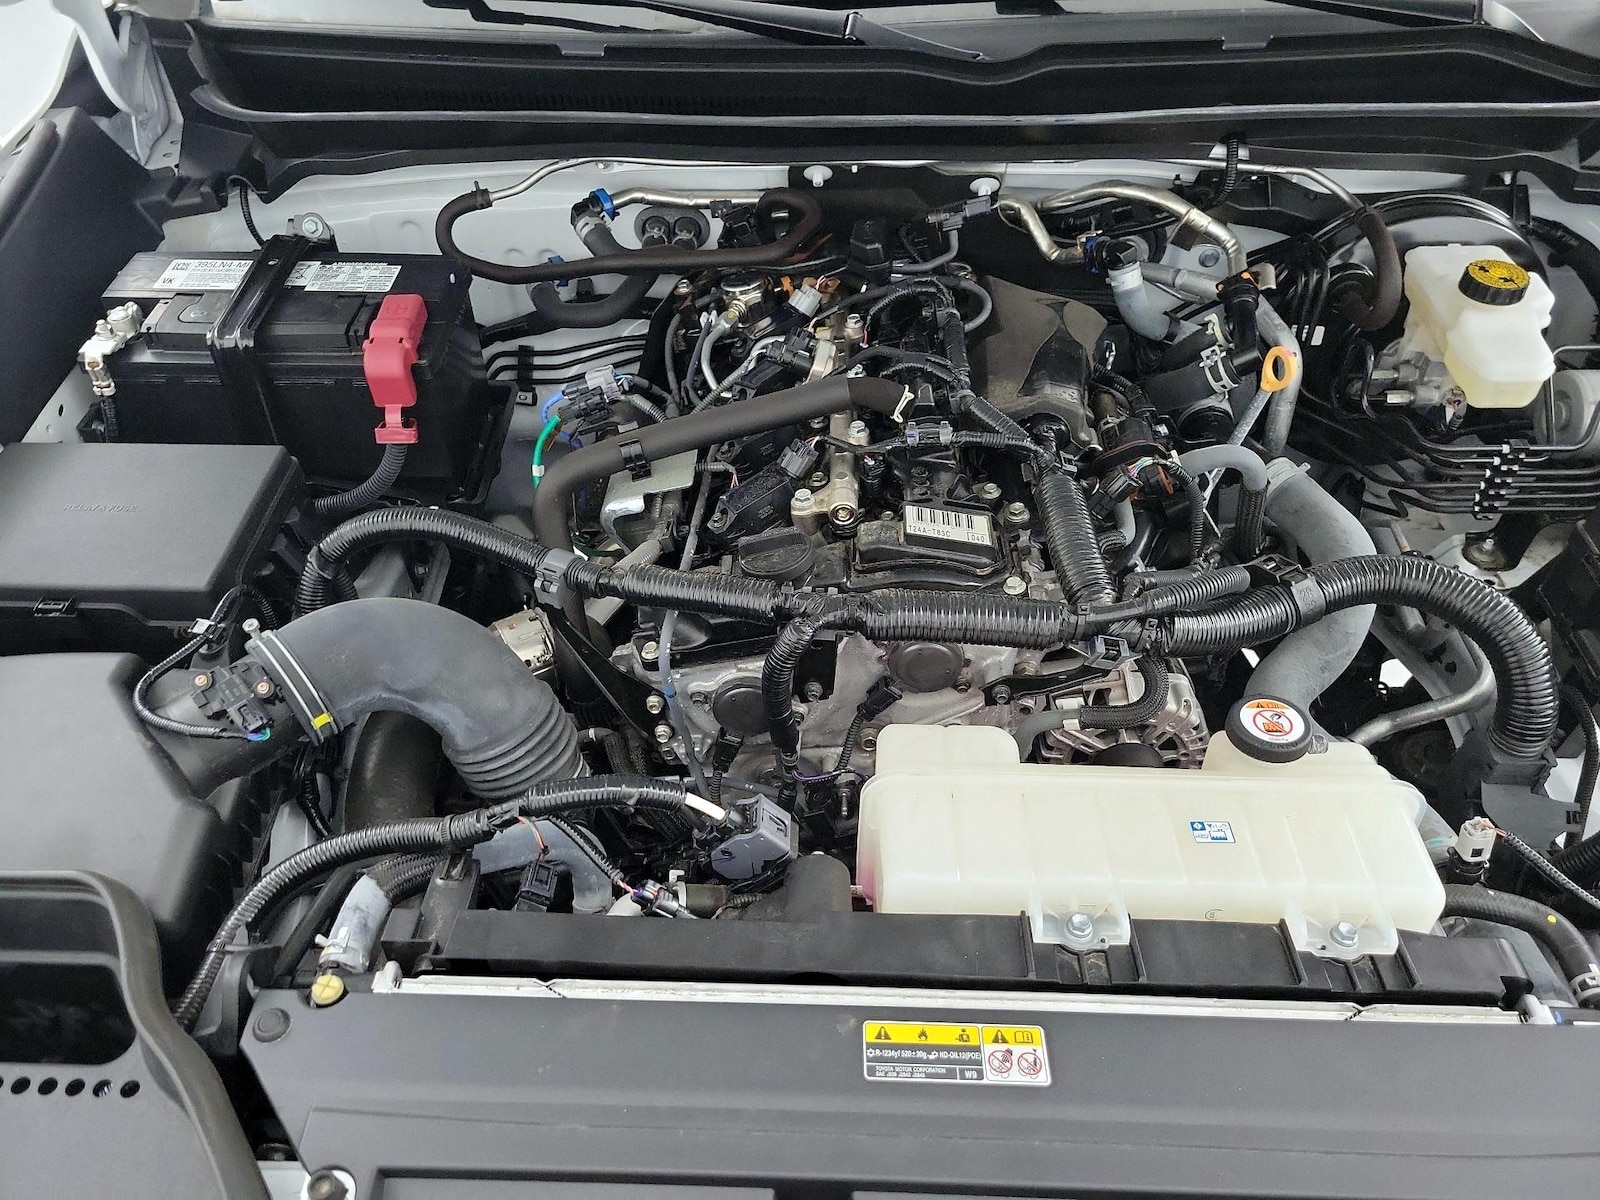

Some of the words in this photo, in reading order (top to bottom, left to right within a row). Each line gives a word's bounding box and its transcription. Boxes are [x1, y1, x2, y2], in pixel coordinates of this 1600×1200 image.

[908, 525, 951, 538] T24A-T83C
[875, 1048, 900, 1059] R-1234yf
[964, 1070, 978, 1078] W9
